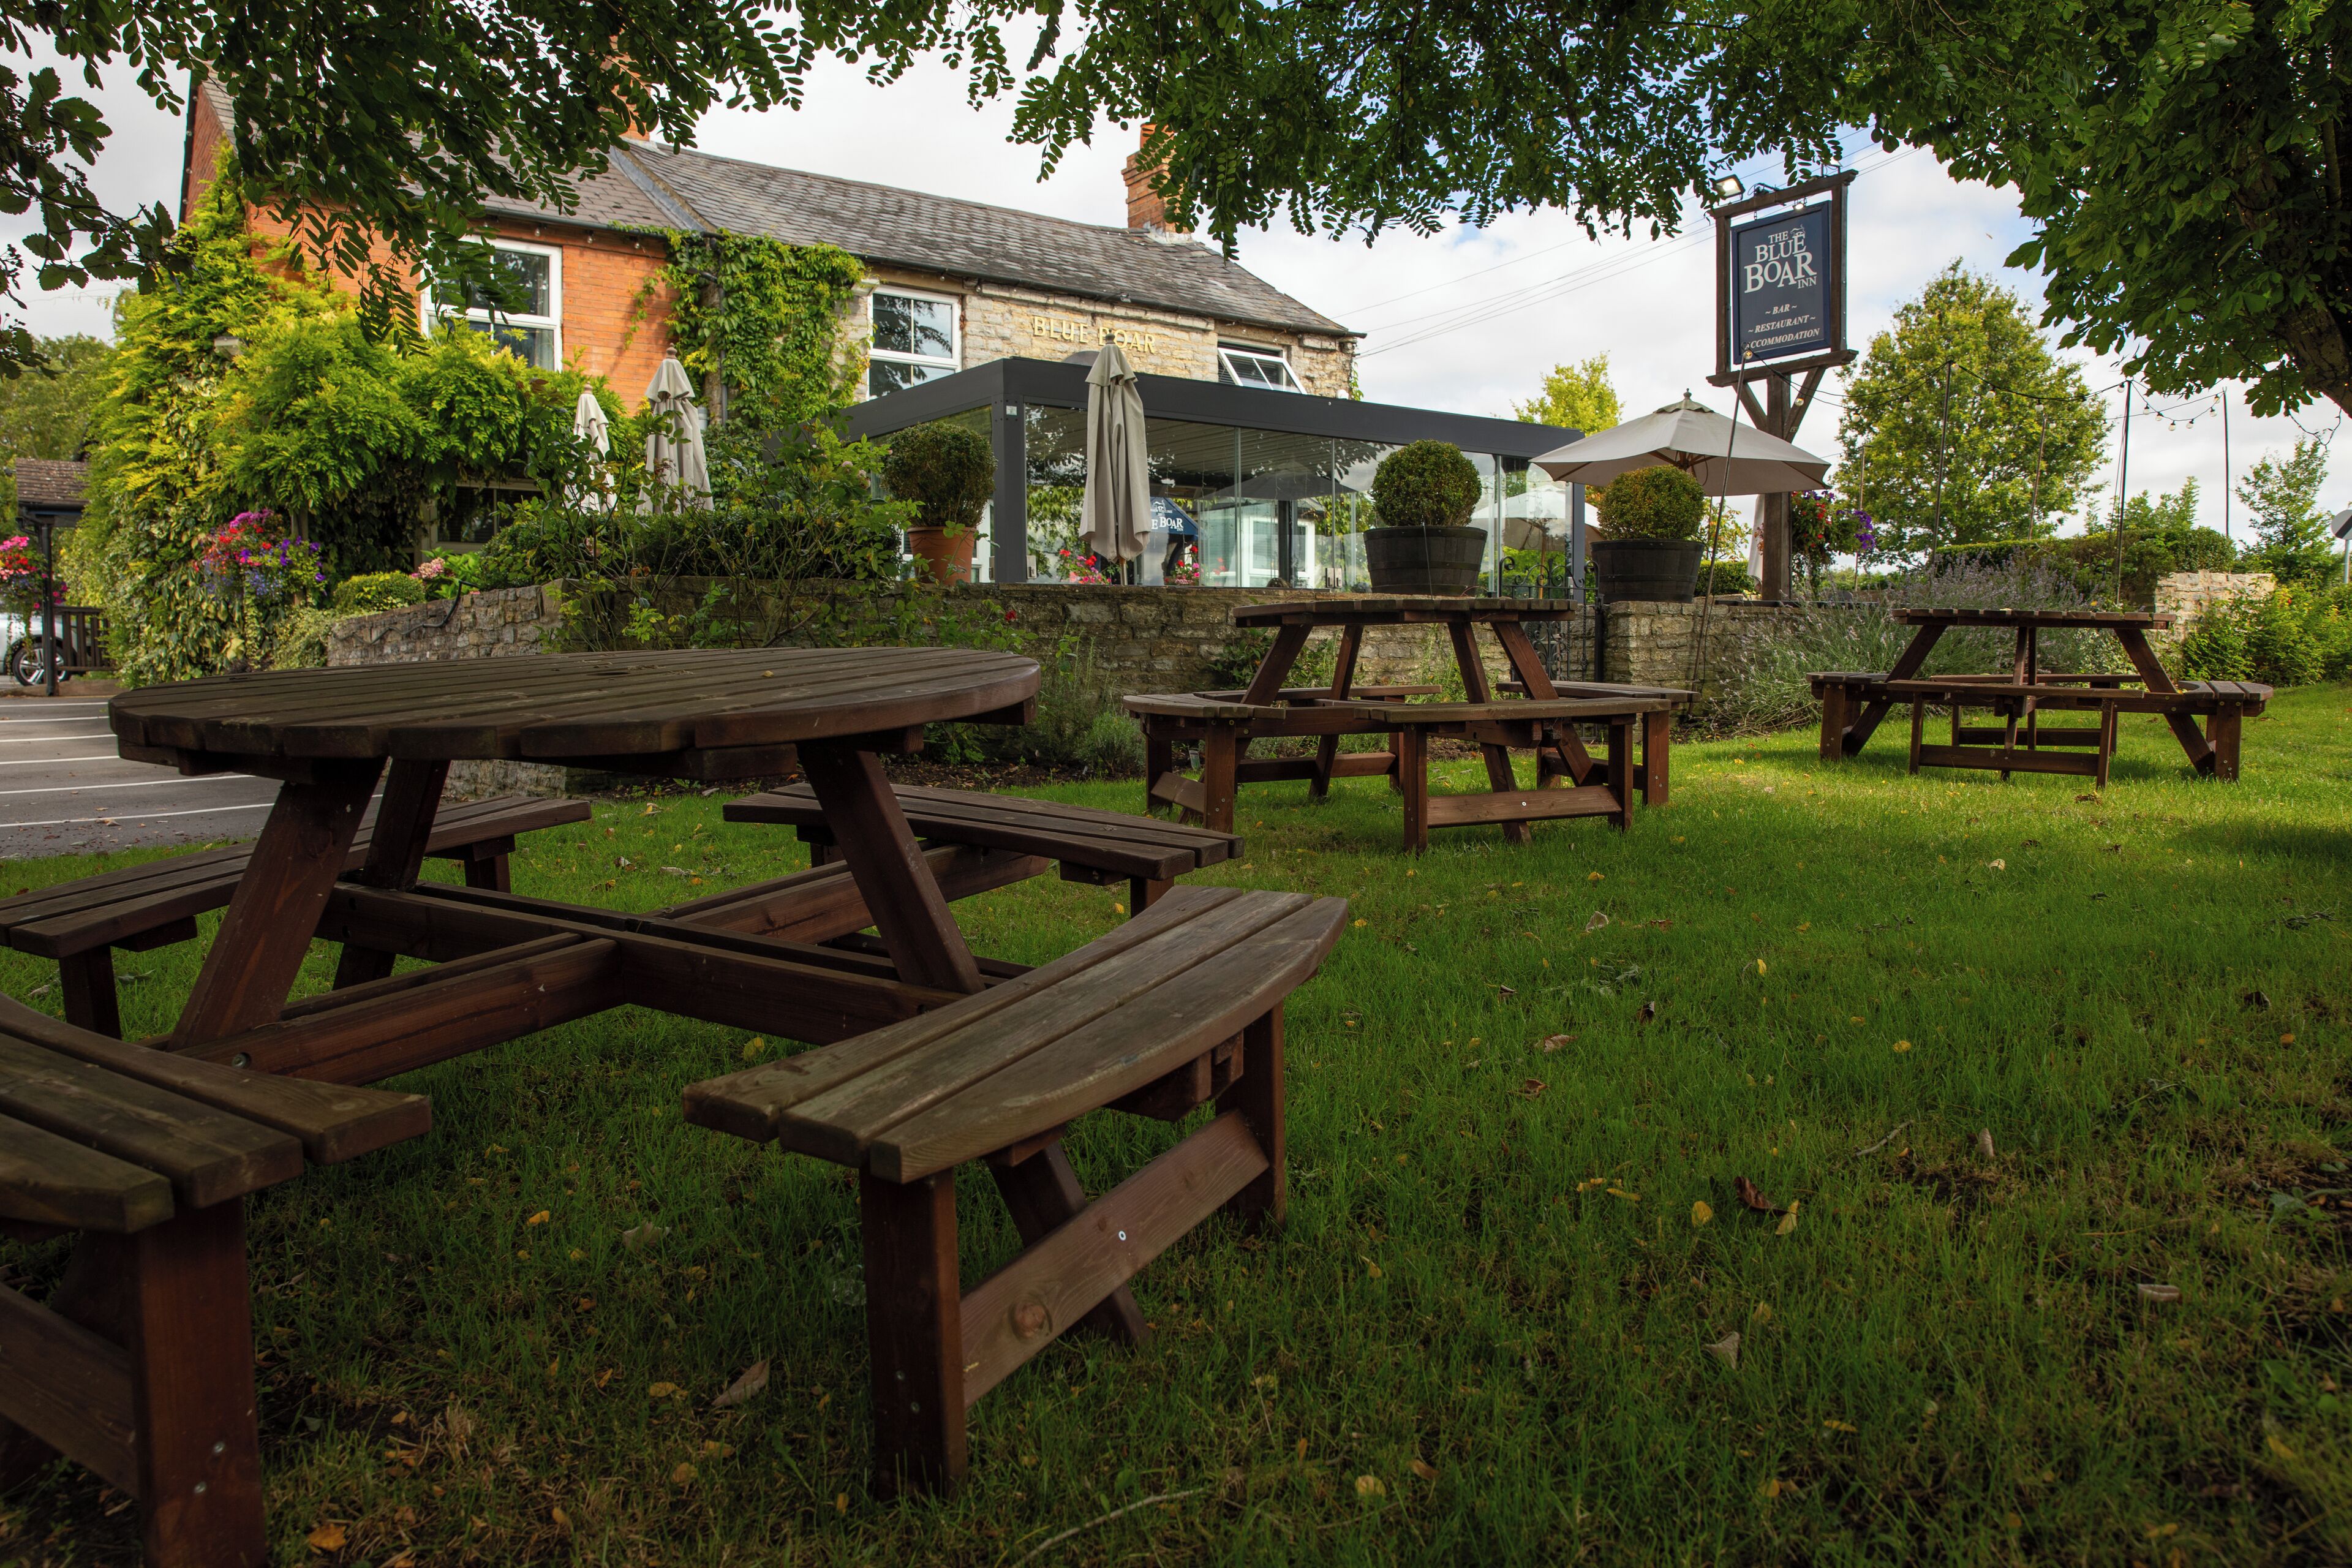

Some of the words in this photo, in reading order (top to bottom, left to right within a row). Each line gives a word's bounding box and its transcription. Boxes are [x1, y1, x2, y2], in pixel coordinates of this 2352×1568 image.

[1768, 231, 1789, 244] THE
[1755, 233, 1806, 263] BLUE
[1744, 252, 1817, 293] BOAR
[1797, 276, 1817, 289] INN
[1772, 304, 1790, 315] BAR
[1033, 316, 1088, 344] BLUE
[1755, 315, 1809, 333] RESTAURANT
[1159, 516, 1183, 529] BOAR
